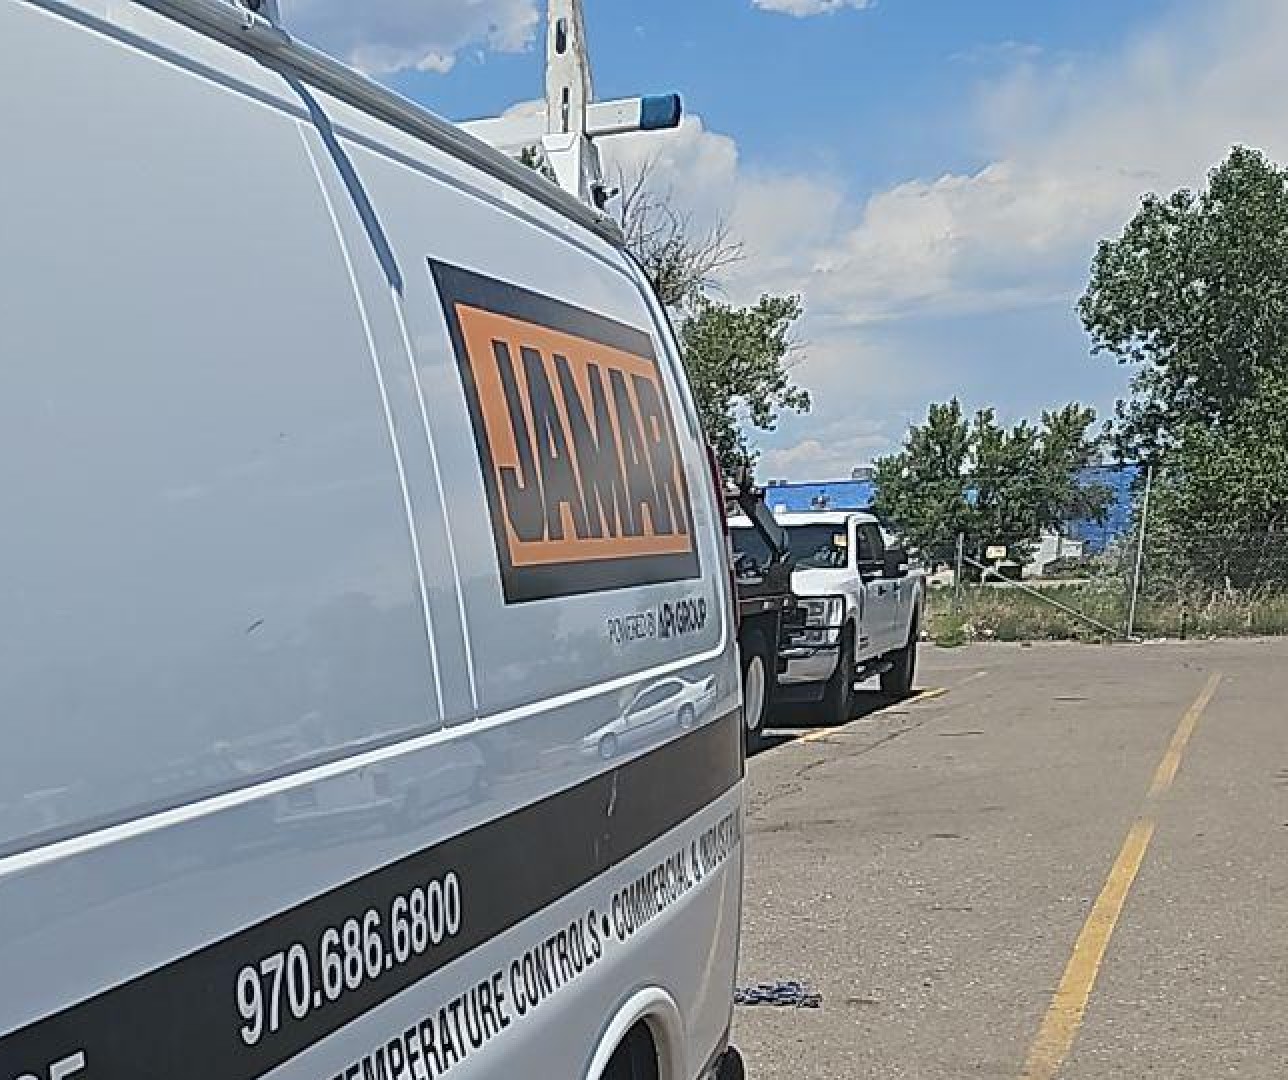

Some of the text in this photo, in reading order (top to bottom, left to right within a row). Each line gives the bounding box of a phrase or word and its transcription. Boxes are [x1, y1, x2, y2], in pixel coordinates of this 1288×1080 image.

[492, 339, 688, 542] JAMAR
[676, 597, 707, 634] GROUP
[236, 871, 461, 1046] 970.686.6800
[510, 909, 601, 1016] CONTROLS
[612, 848, 693, 941] COMMERCIAL
